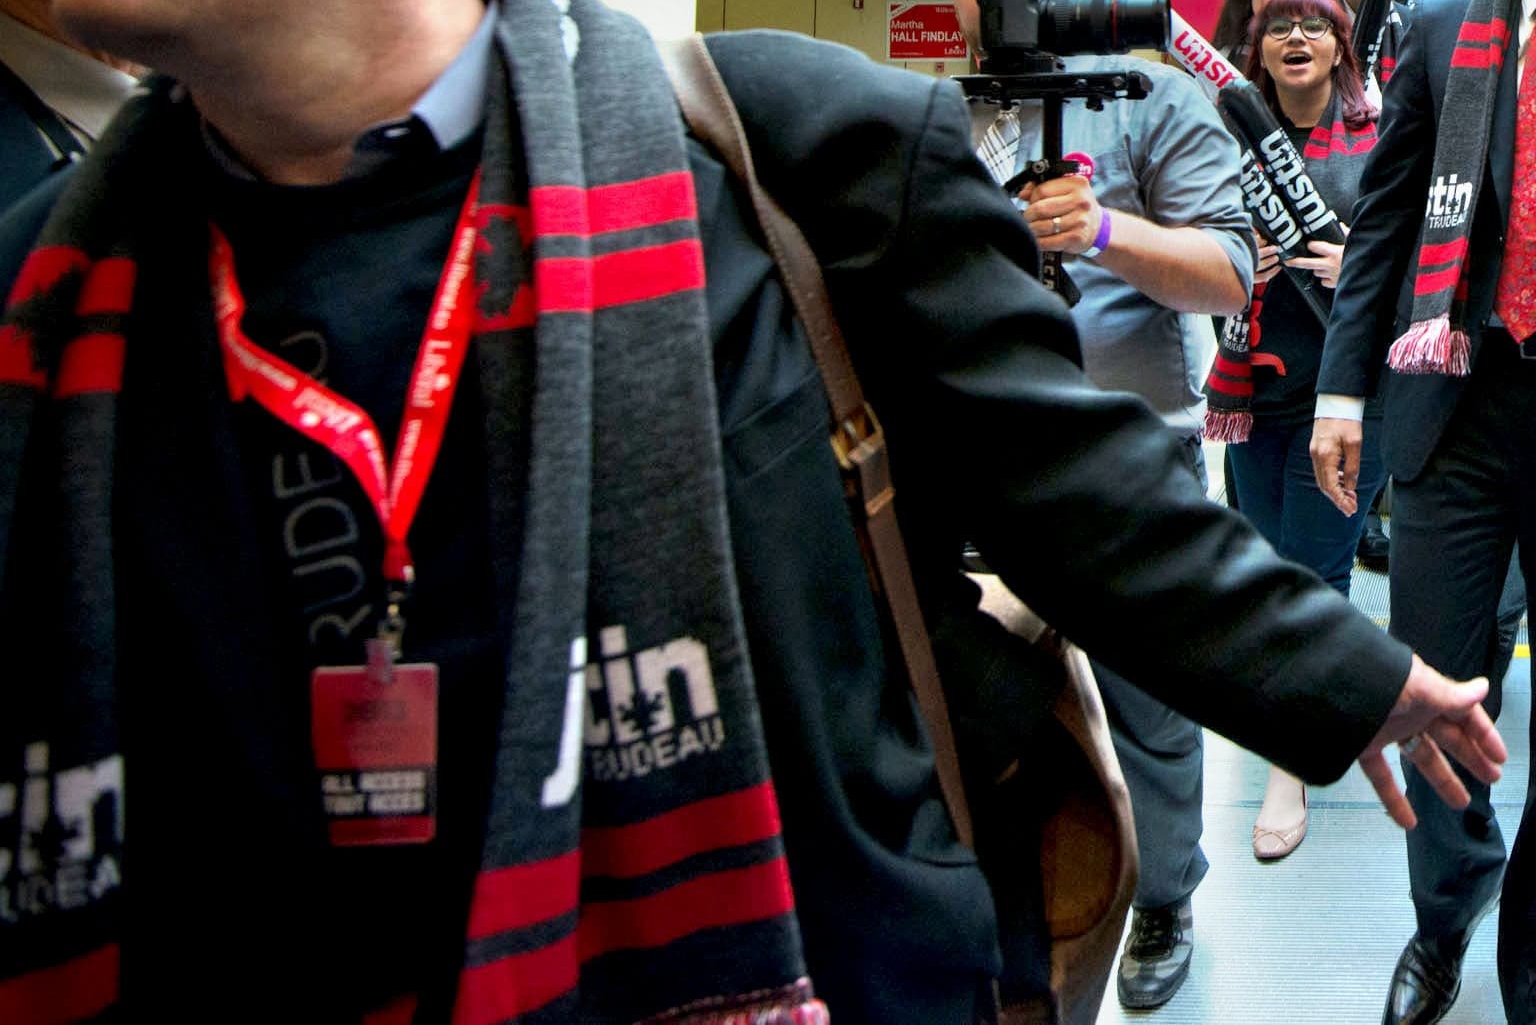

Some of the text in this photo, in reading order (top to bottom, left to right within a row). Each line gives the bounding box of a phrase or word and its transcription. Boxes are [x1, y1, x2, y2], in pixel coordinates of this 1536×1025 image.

[890, 20, 924, 30] Martha
[891, 31, 964, 43] HALL FINDLAY
[1259, 129, 1339, 236] justin
